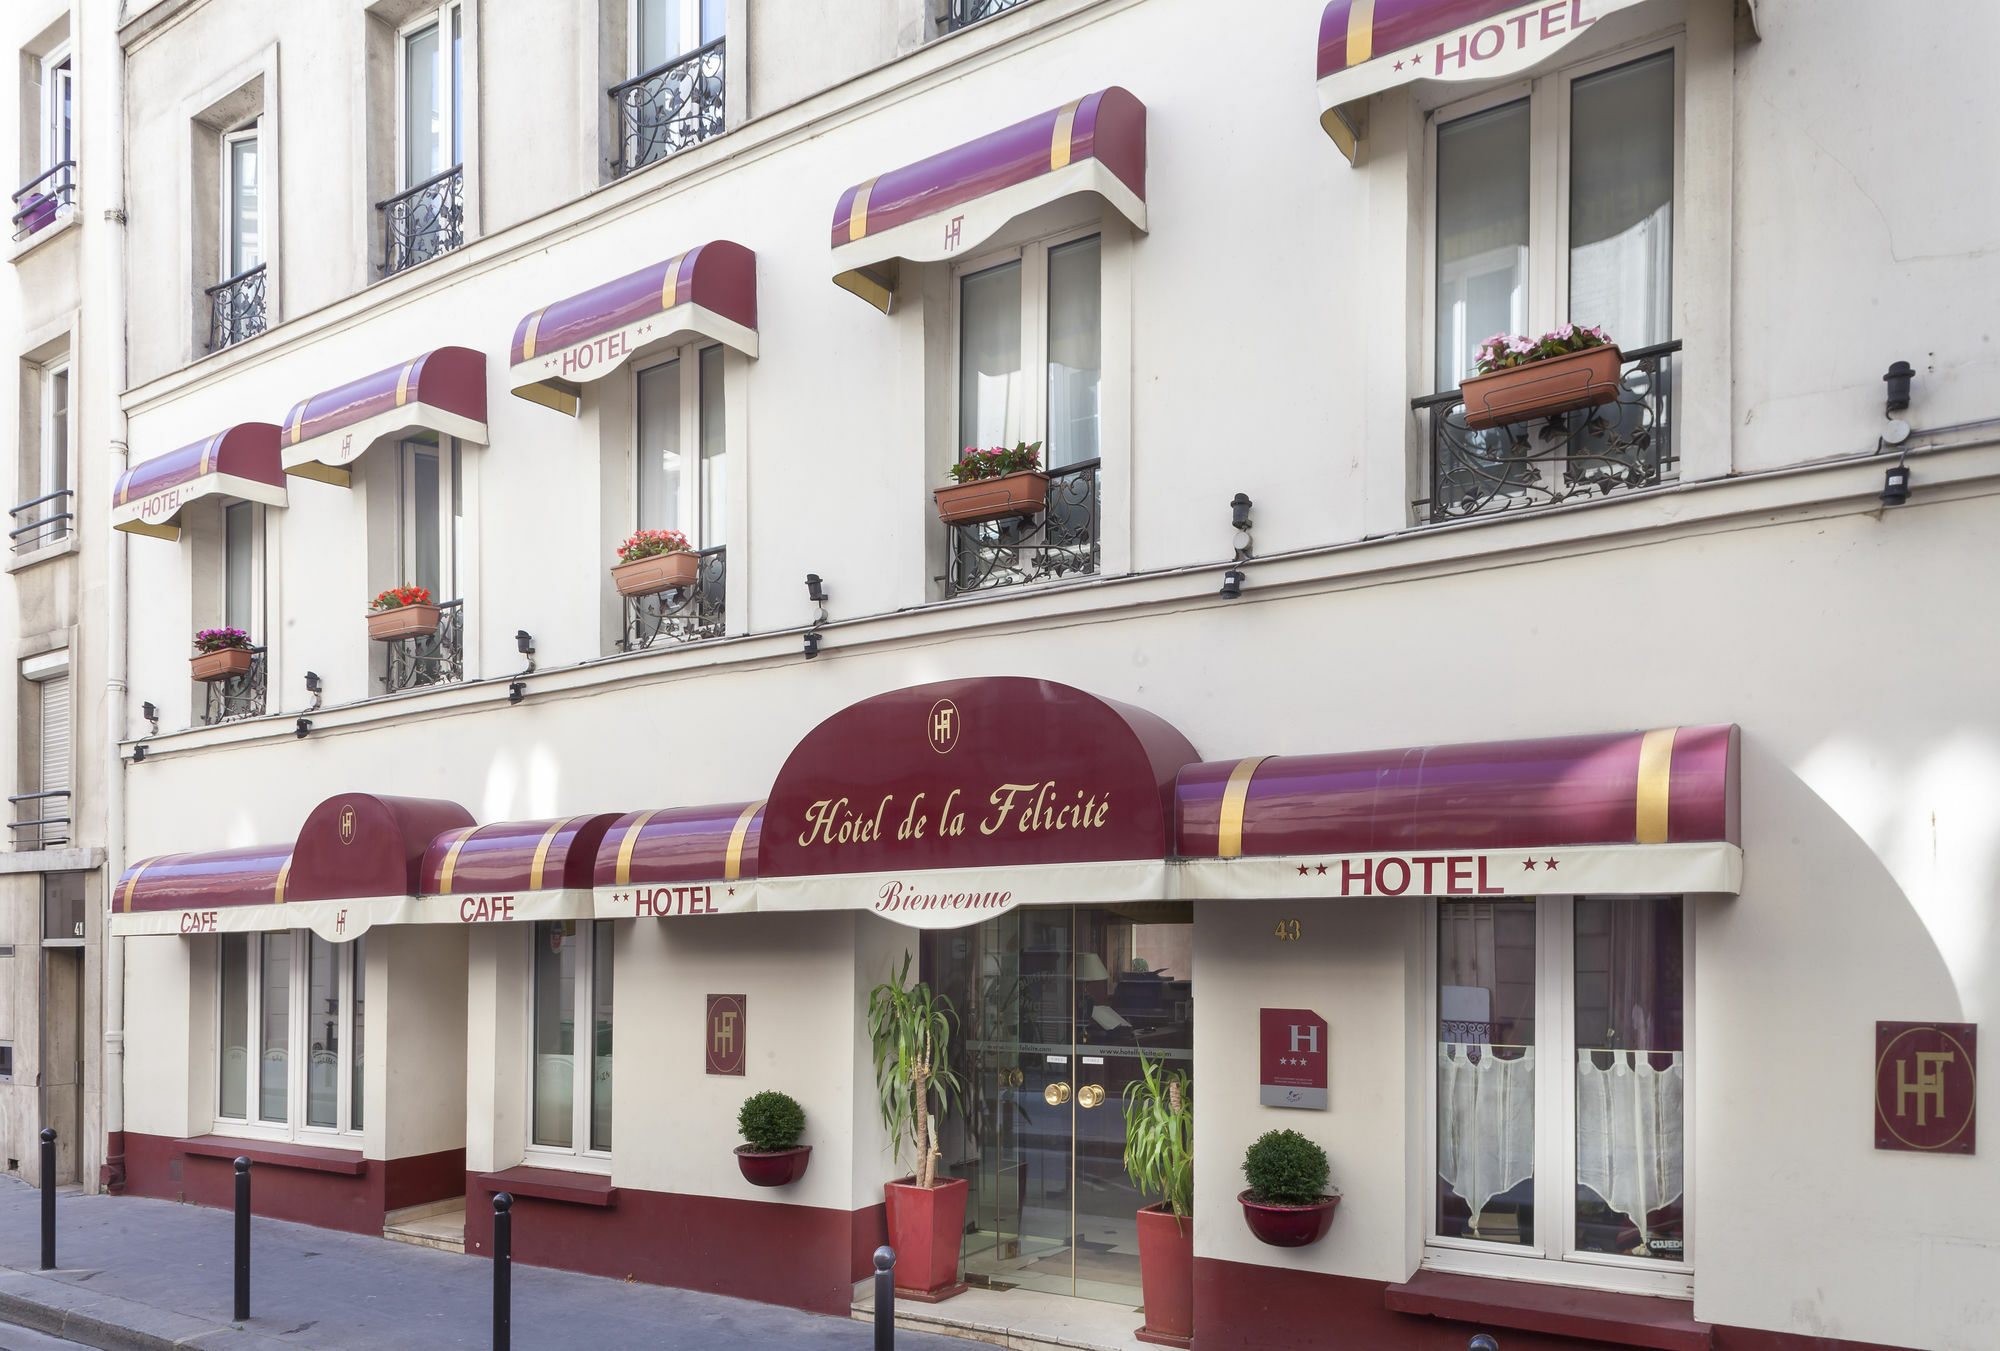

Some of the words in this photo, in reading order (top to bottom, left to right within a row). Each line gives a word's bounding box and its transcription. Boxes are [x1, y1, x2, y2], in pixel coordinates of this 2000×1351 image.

[1435, 0, 1597, 76] HOTEL
[562, 330, 632, 376] HOTEL
[141, 489, 183, 518] HOTEL
[798, 795, 893, 847] Hôtel
[897, 792, 927, 841] de
[938, 788, 966, 837] la
[979, 781, 1110, 836] Félicité
[1341, 856, 1504, 896] HOTEL
[460, 896, 515, 922] CAFE
[635, 886, 719, 916] HOTEL
[875, 880, 1012, 912] Bienvenue
[74, 921, 84, 936] 41
[180, 911, 218, 933] CAFE
[1274, 919, 1301, 941] 43
[1288, 1024, 1320, 1053] H
